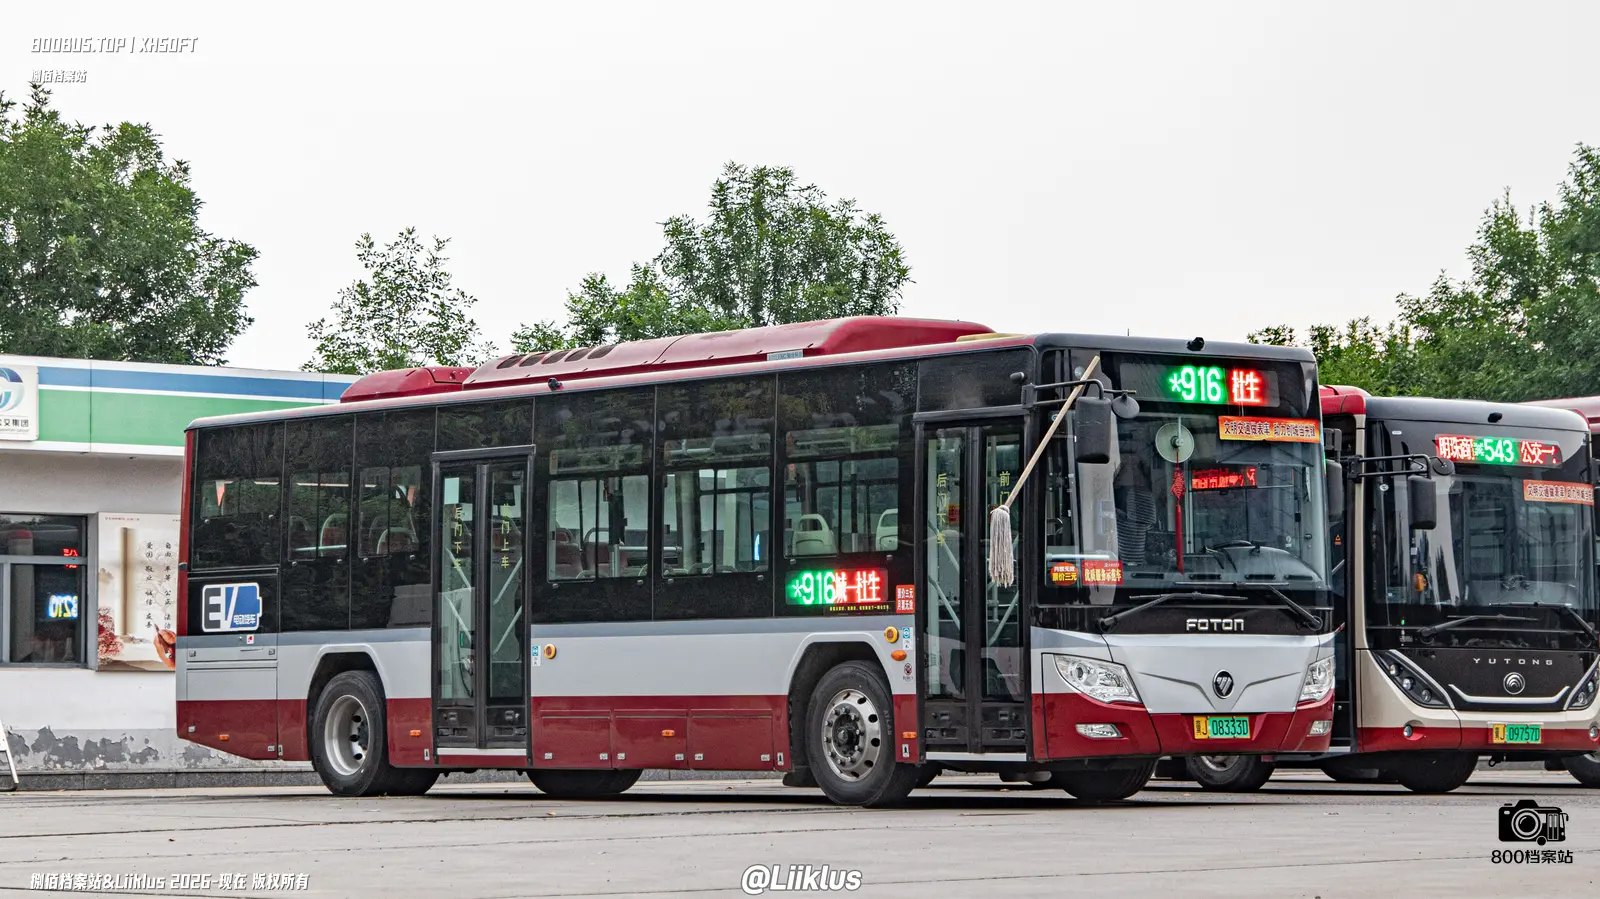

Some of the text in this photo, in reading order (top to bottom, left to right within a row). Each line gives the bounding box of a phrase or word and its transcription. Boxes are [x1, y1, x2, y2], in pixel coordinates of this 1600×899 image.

[0, 418, 29, 427] 交集团
[1186, 618, 1245, 631] FOTON
[1472, 658, 1553, 666] YUTONG
